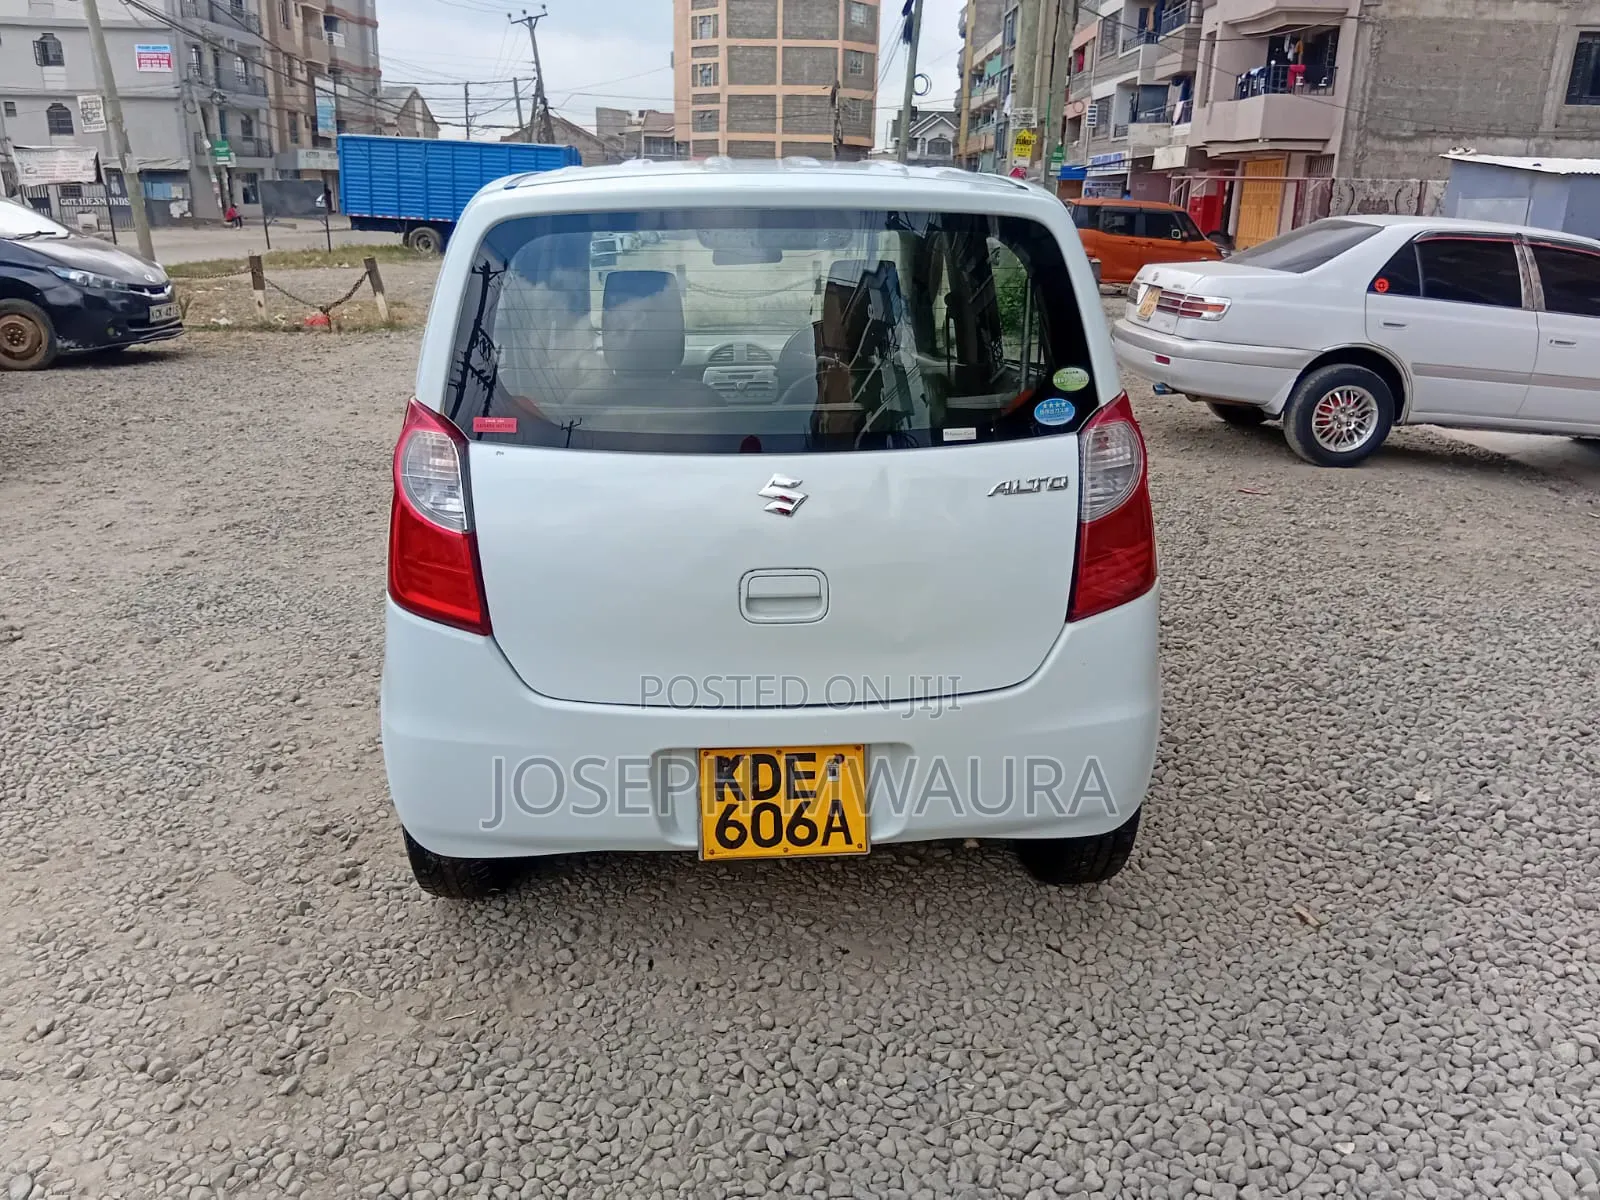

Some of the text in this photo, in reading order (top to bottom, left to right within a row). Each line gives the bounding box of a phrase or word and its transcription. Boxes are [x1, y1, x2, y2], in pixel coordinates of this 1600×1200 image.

[987, 475, 1068, 497] ALTO
[715, 752, 817, 802] KDE
[715, 801, 853, 850] 606A
